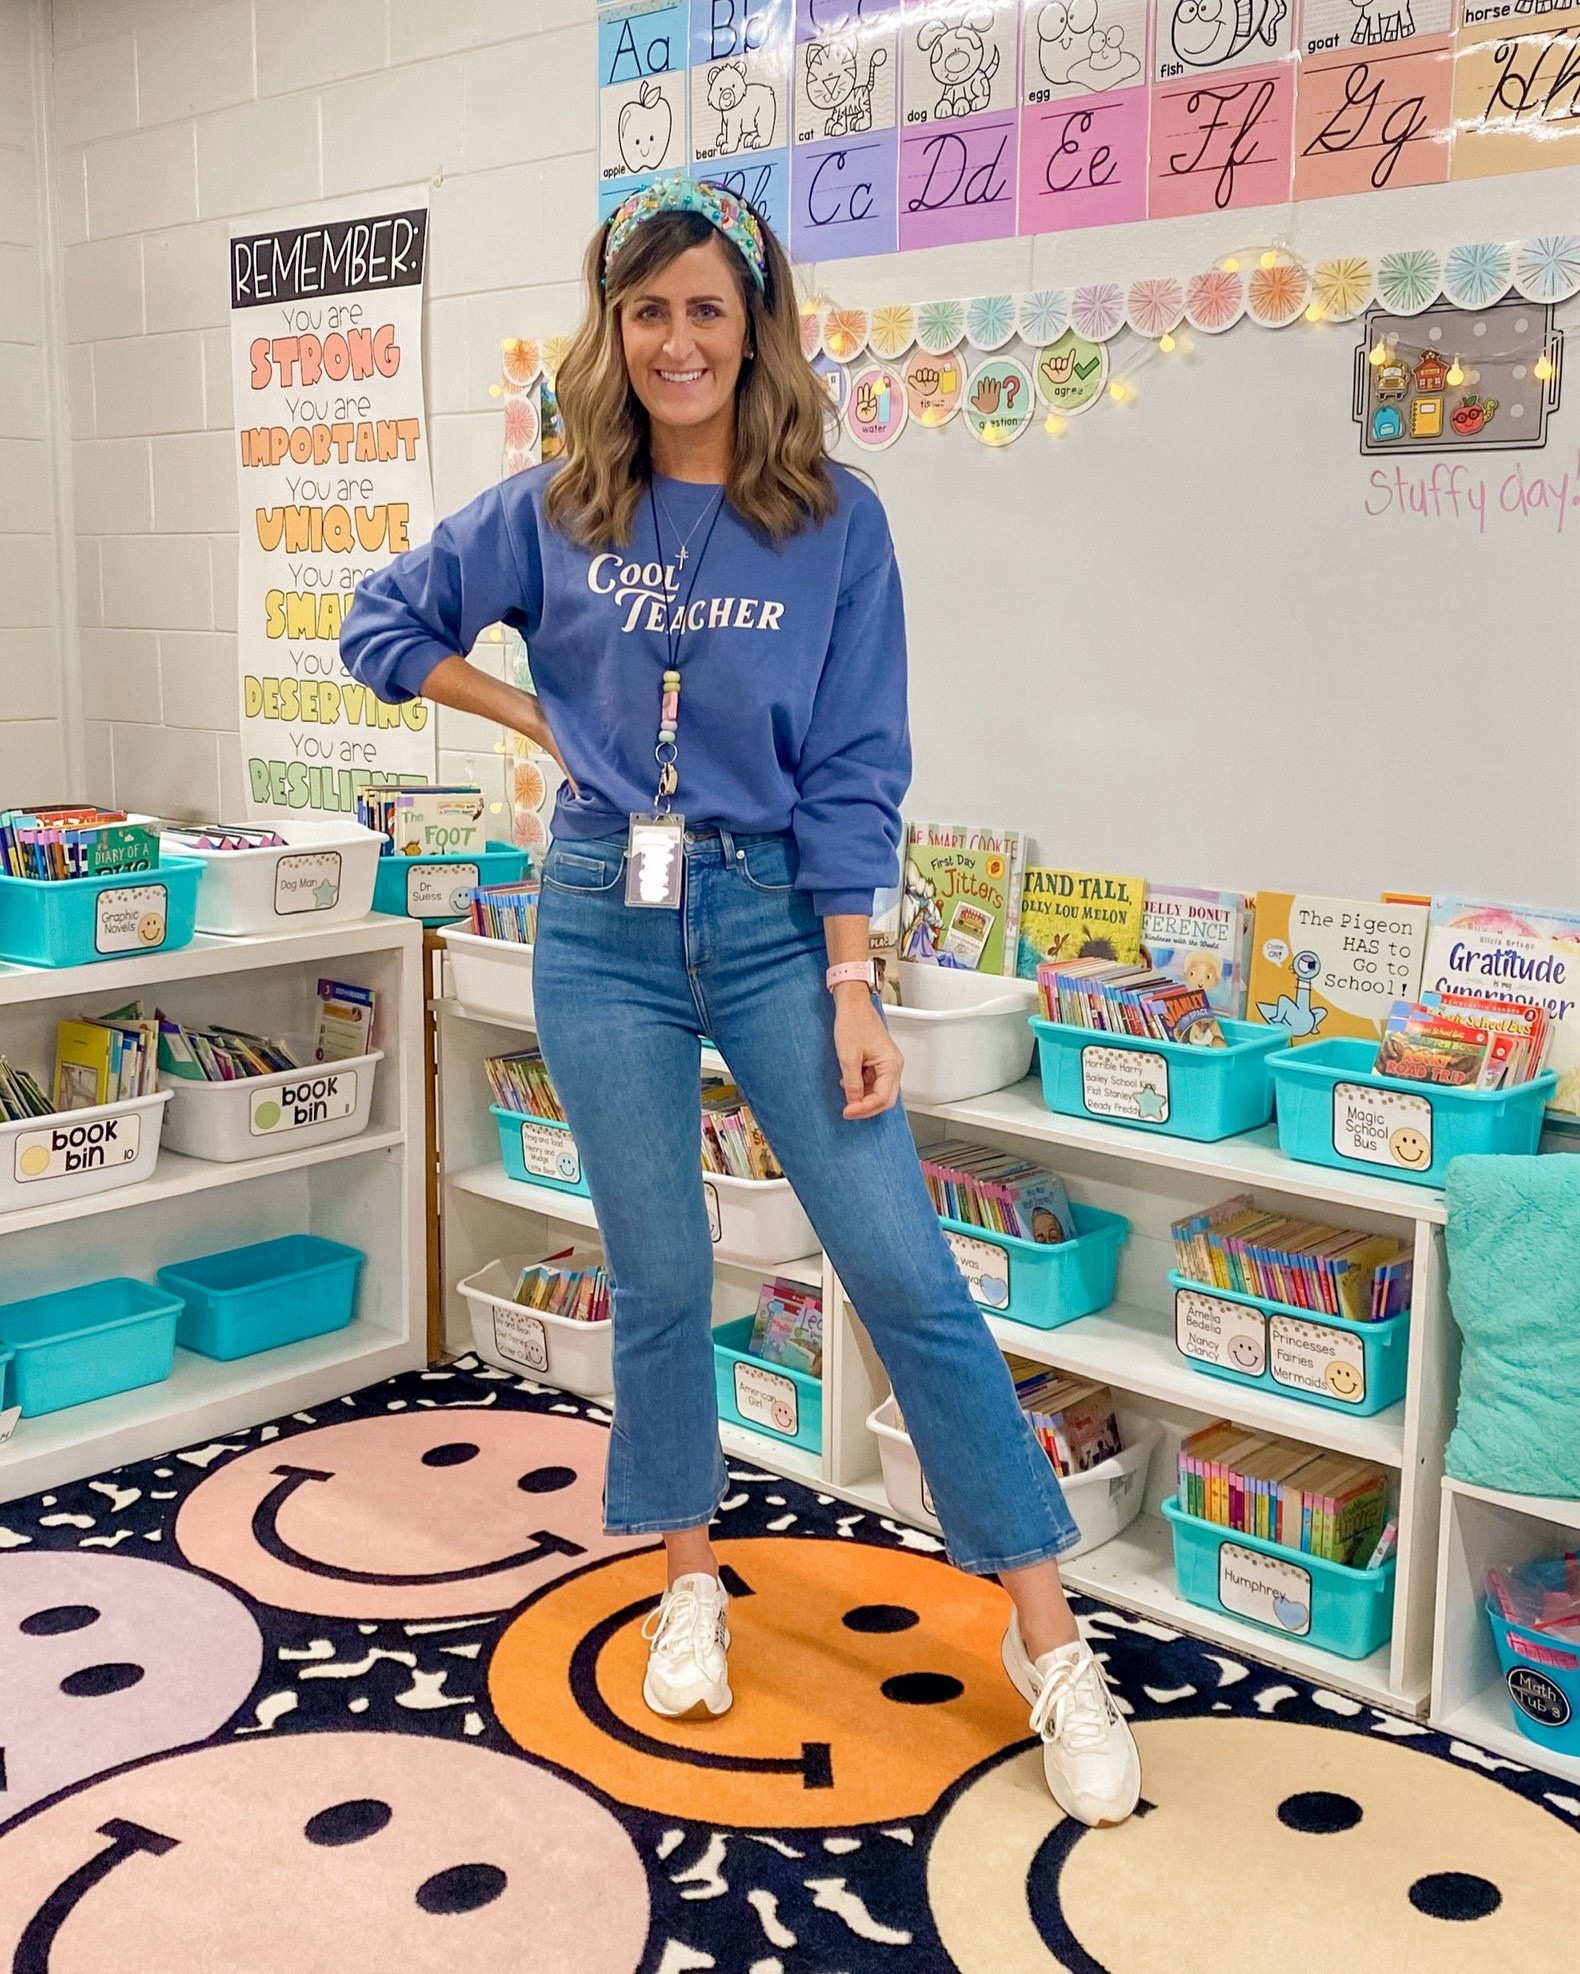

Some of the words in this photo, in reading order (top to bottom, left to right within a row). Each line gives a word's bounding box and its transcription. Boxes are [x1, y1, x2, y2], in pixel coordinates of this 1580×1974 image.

[1465, 5, 1511, 23] horse
[609, 19, 670, 83] Aa
[1307, 34, 1340, 54] goat
[1160, 62, 1184, 78] fish
[1029, 89, 1051, 102] egg
[907, 109, 927, 123] dog
[1303, 64, 1427, 188] Gg
[798, 129, 814, 141] cat
[1170, 81, 1275, 208] Ff
[695, 148, 717, 160] bear
[1046, 110, 1118, 192] Ee
[603, 164, 626, 179] apple
[908, 134, 1007, 213] Dd
[808, 151, 874, 225] Cc
[235, 217, 419, 301] REMEMBER:
[282, 309, 322, 333] You
[328, 304, 363, 328] are
[250, 324, 401, 390] STRONG
[1054, 387, 1083, 397] agree
[286, 397, 328, 422] You
[334, 396, 371, 420] are
[862, 424, 887, 434] water
[979, 417, 1018, 430] qestion
[240, 418, 420, 467] IMPORTANT
[286, 477, 331, 501] You
[337, 478, 374, 500] are
[1365, 463, 1485, 533] Stuffy
[256, 503, 410, 554] UNIQUE
[288, 563, 333, 587] You
[265, 588, 354, 641] SMA
[288, 650, 333, 675] You
[244, 675, 428, 732] DESERVING
[289, 732, 333, 759] You
[340, 741, 377, 762] are
[248, 758, 428, 814] RESILI
[402, 811, 424, 824] The
[424, 825, 476, 846] FOOT
[95, 848, 124, 865] DIARY
[128, 845, 140, 858] OF
[143, 844, 149, 855] A
[931, 856, 953, 870] First
[956, 853, 976, 869] Day
[280, 879, 297, 891] Dog
[300, 878, 317, 889] Man
[412, 890, 442, 901] Suess
[420, 882, 431, 892] Dr
[942, 868, 1003, 909] Jitters
[1023, 872, 1074, 897] TAND
[1079, 879, 1132, 905] TALL,
[102, 911, 139, 923] Graphic
[1021, 899, 1052, 915] OLLY
[1054, 903, 1079, 918] LOU
[1081, 906, 1128, 925] MELON
[1143, 901, 1182, 916] JELLY
[1188, 906, 1231, 923] DONUT
[1299, 910, 1334, 928] The
[1340, 913, 1413, 936] Pigeon
[104, 922, 136, 934] Novels
[1141, 914, 1229, 941] FERENCE
[1343, 936, 1380, 954] HAS
[1389, 941, 1411, 958] to
[1353, 958, 1377, 973] Go
[1387, 961, 1409, 977] to
[1450, 942, 1566, 984] Gratitude
[1324, 974, 1408, 997] School!
[1085, 1060, 1116, 1072] Horrible
[1120, 1064, 1143, 1075] Harry
[1385, 1060, 1427, 1078] ROAD
[1431, 1067, 1466, 1085] TRIP
[282, 1076, 338, 1106] book
[1086, 1073, 1108, 1085] Bailey
[1111, 1076, 1137, 1087] School
[1087, 1086, 1101, 1095] Flat
[1104, 1089, 1133, 1102] Stanley
[294, 1100, 327, 1126] bin
[1088, 1099, 1112, 1112] Ready
[1114, 1103, 1138, 1115] Fredd
[1348, 1106, 1385, 1126] Magic
[52, 1120, 117, 1151] book
[1345, 1119, 1388, 1139] School
[1354, 1134, 1377, 1151] Bus
[65, 1146, 104, 1171] bin
[124, 1149, 134, 1161] 10
[1186, 1316, 1221, 1335] Bedelia
[1187, 1306, 1221, 1324] Amelia
[1186, 1342, 1219, 1361] Clancy
[1189, 1332, 1220, 1350] Nancy
[1273, 1330, 1336, 1356] Princesses
[1277, 1349, 1314, 1368] Fairies
[1273, 1366, 1328, 1390] Mermaids
[739, 1382, 777, 1402] American
[748, 1396, 763, 1409] Girl
[1224, 1567, 1288, 1604] Humphrey
[1520, 1673, 1556, 1702] Math
[1518, 1690, 1547, 1712] Tub
